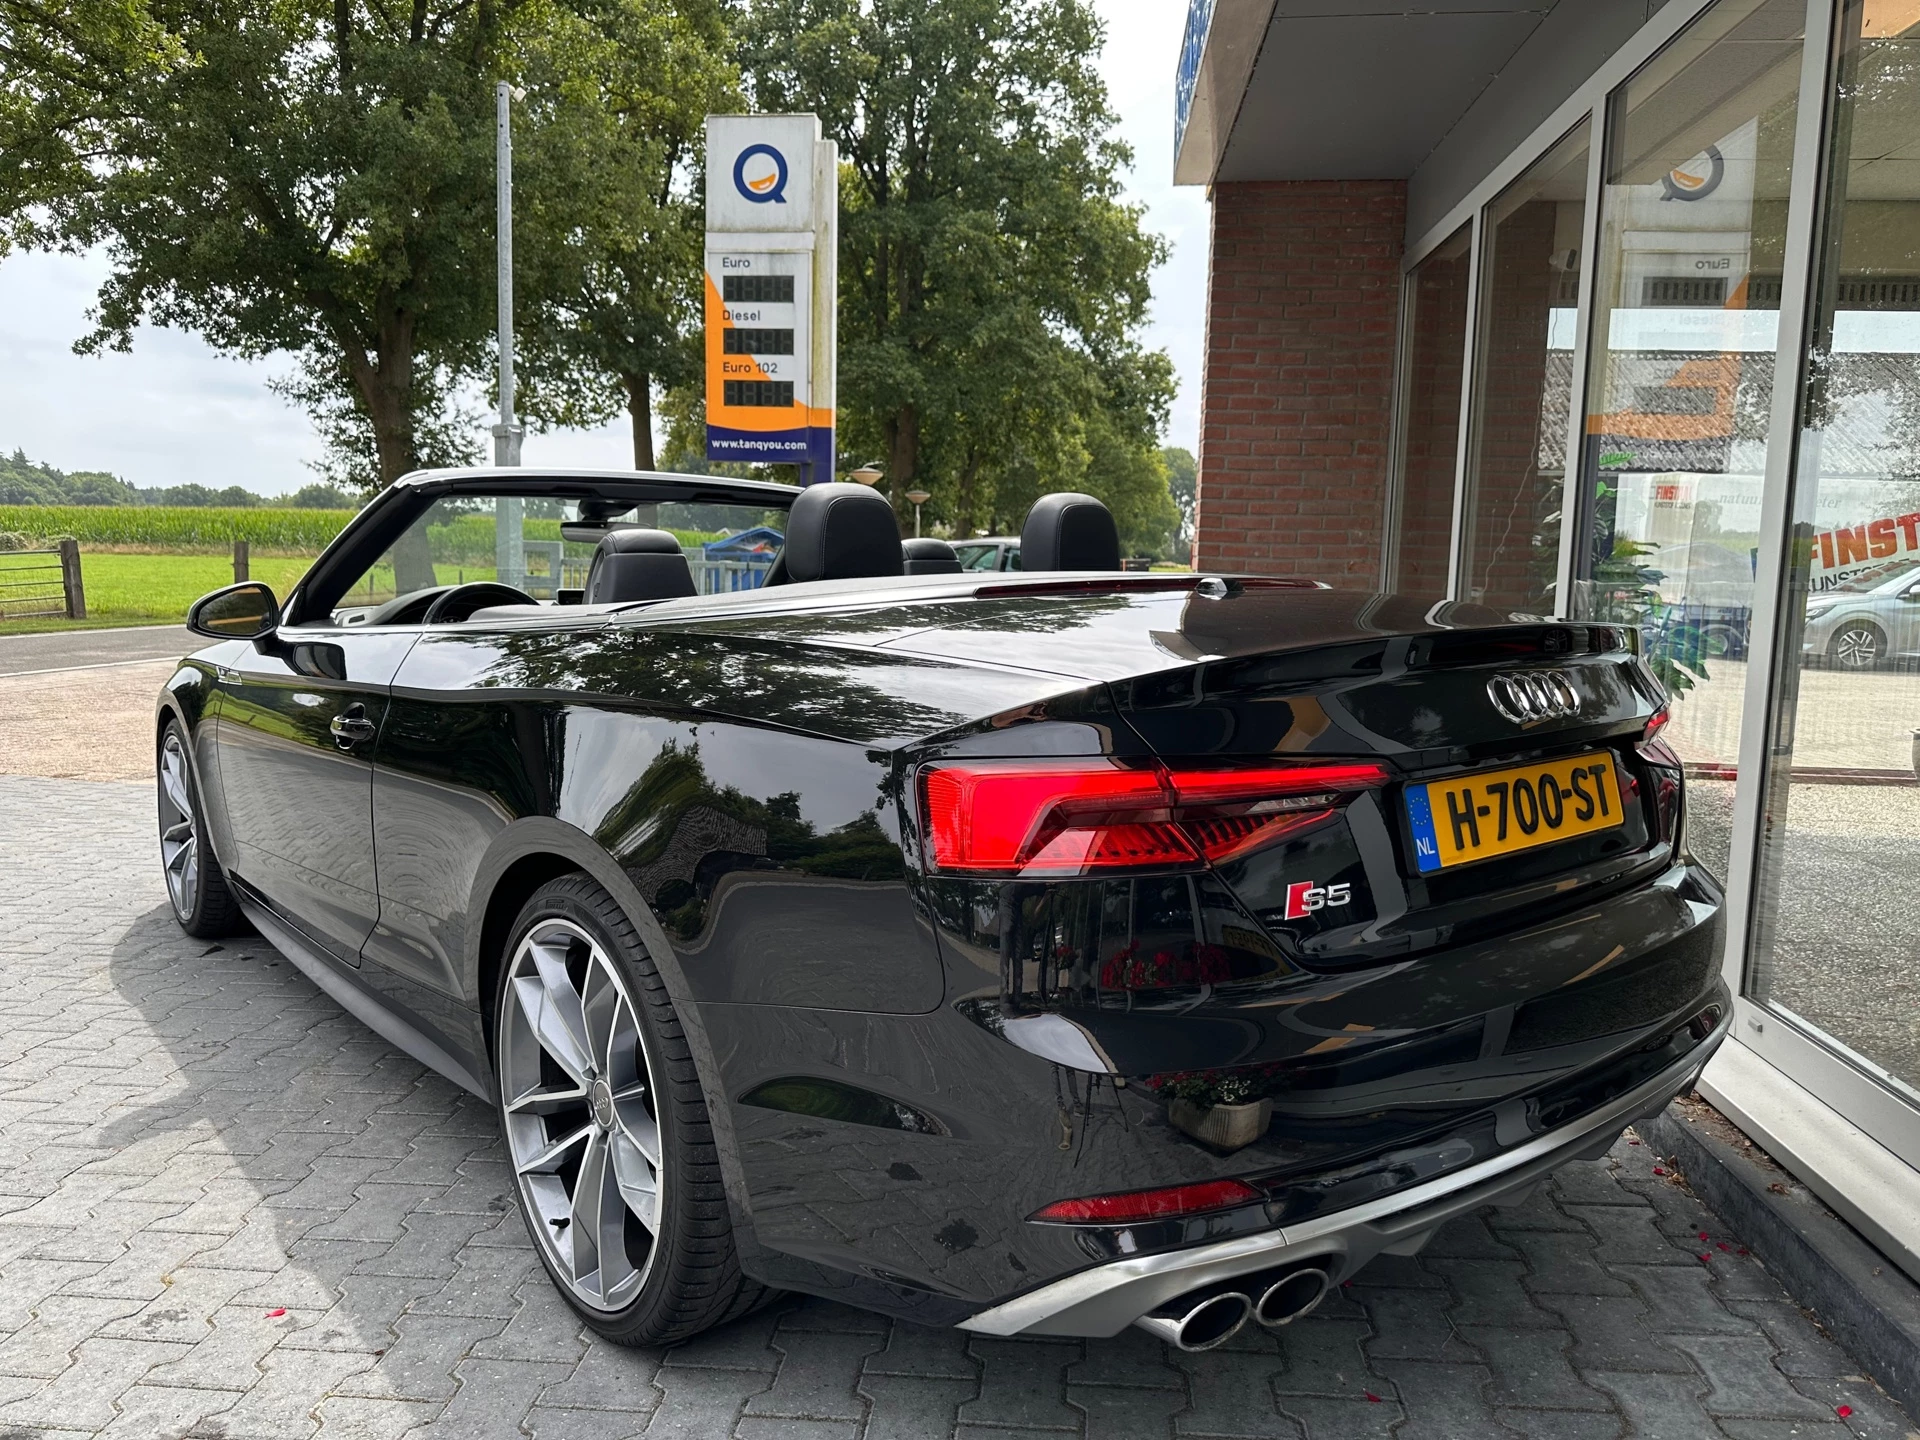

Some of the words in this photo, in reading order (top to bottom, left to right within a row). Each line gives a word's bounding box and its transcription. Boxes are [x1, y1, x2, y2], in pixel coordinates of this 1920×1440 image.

[722, 257, 751, 268] Euro
[722, 310, 761, 321] Diesel
[723, 362, 751, 373] Euro
[755, 362, 778, 374] 102
[711, 438, 807, 451] www.tanqyou.com
[1446, 764, 1608, 851] H-700-ST
[1416, 836, 1436, 857] NL
[1301, 882, 1351, 912] S5
